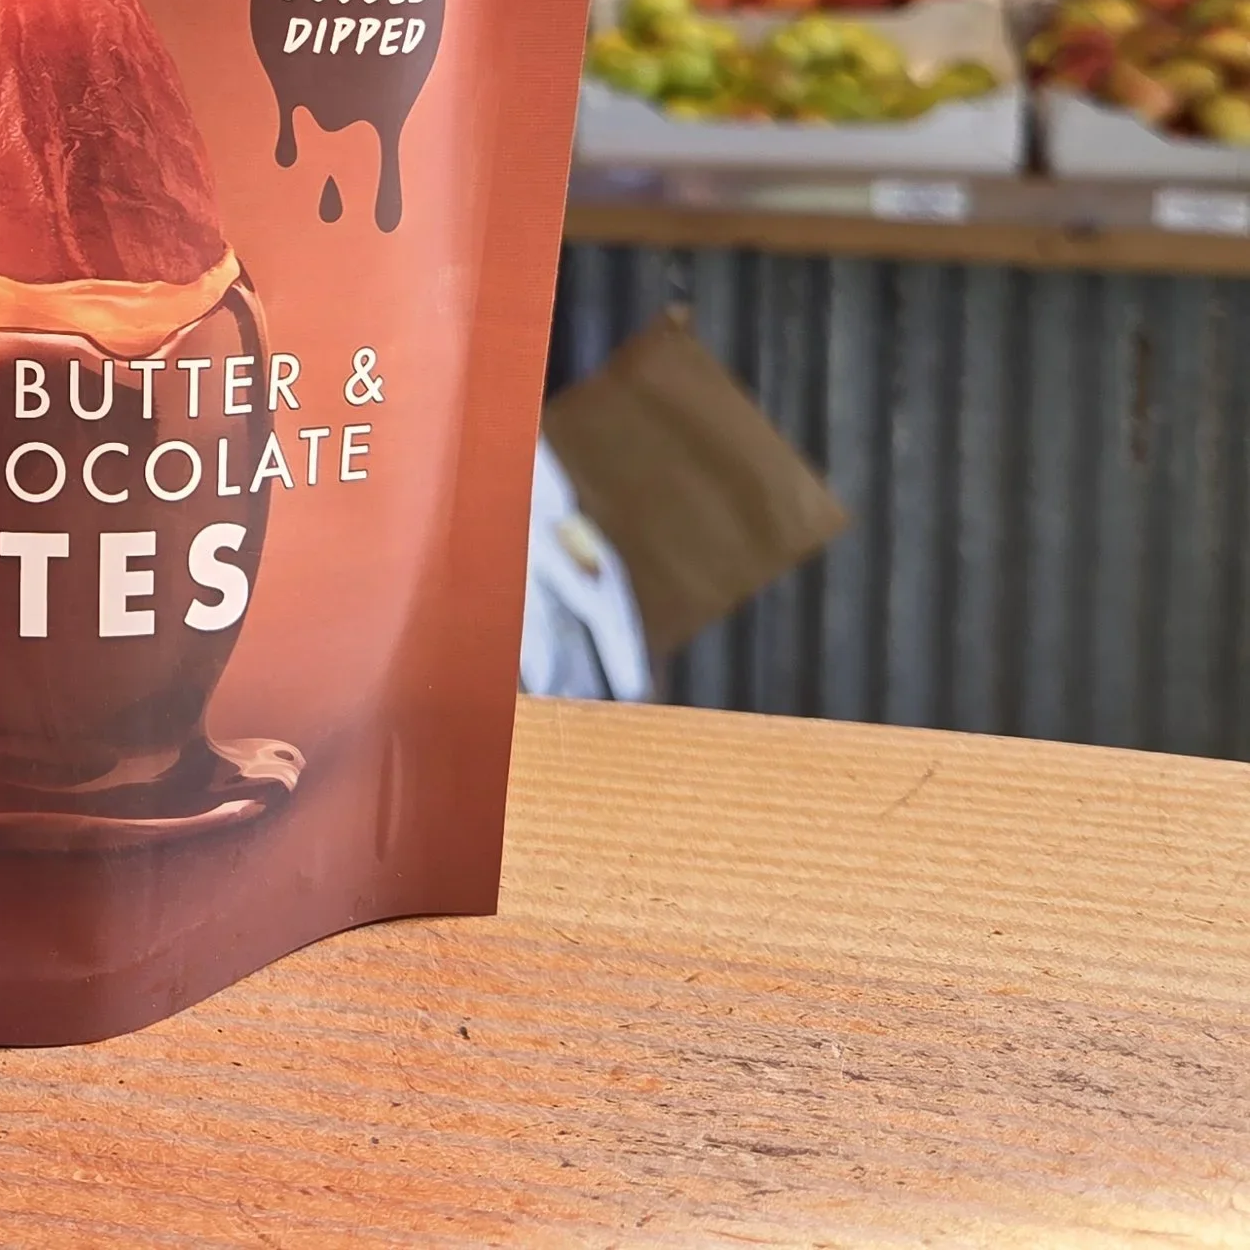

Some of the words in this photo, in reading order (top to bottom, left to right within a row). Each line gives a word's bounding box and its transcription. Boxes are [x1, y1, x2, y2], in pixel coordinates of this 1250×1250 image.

[282, 17, 427, 57] DIPPED
[12, 348, 303, 422] BUTTER
[344, 346, 386, 406] &
